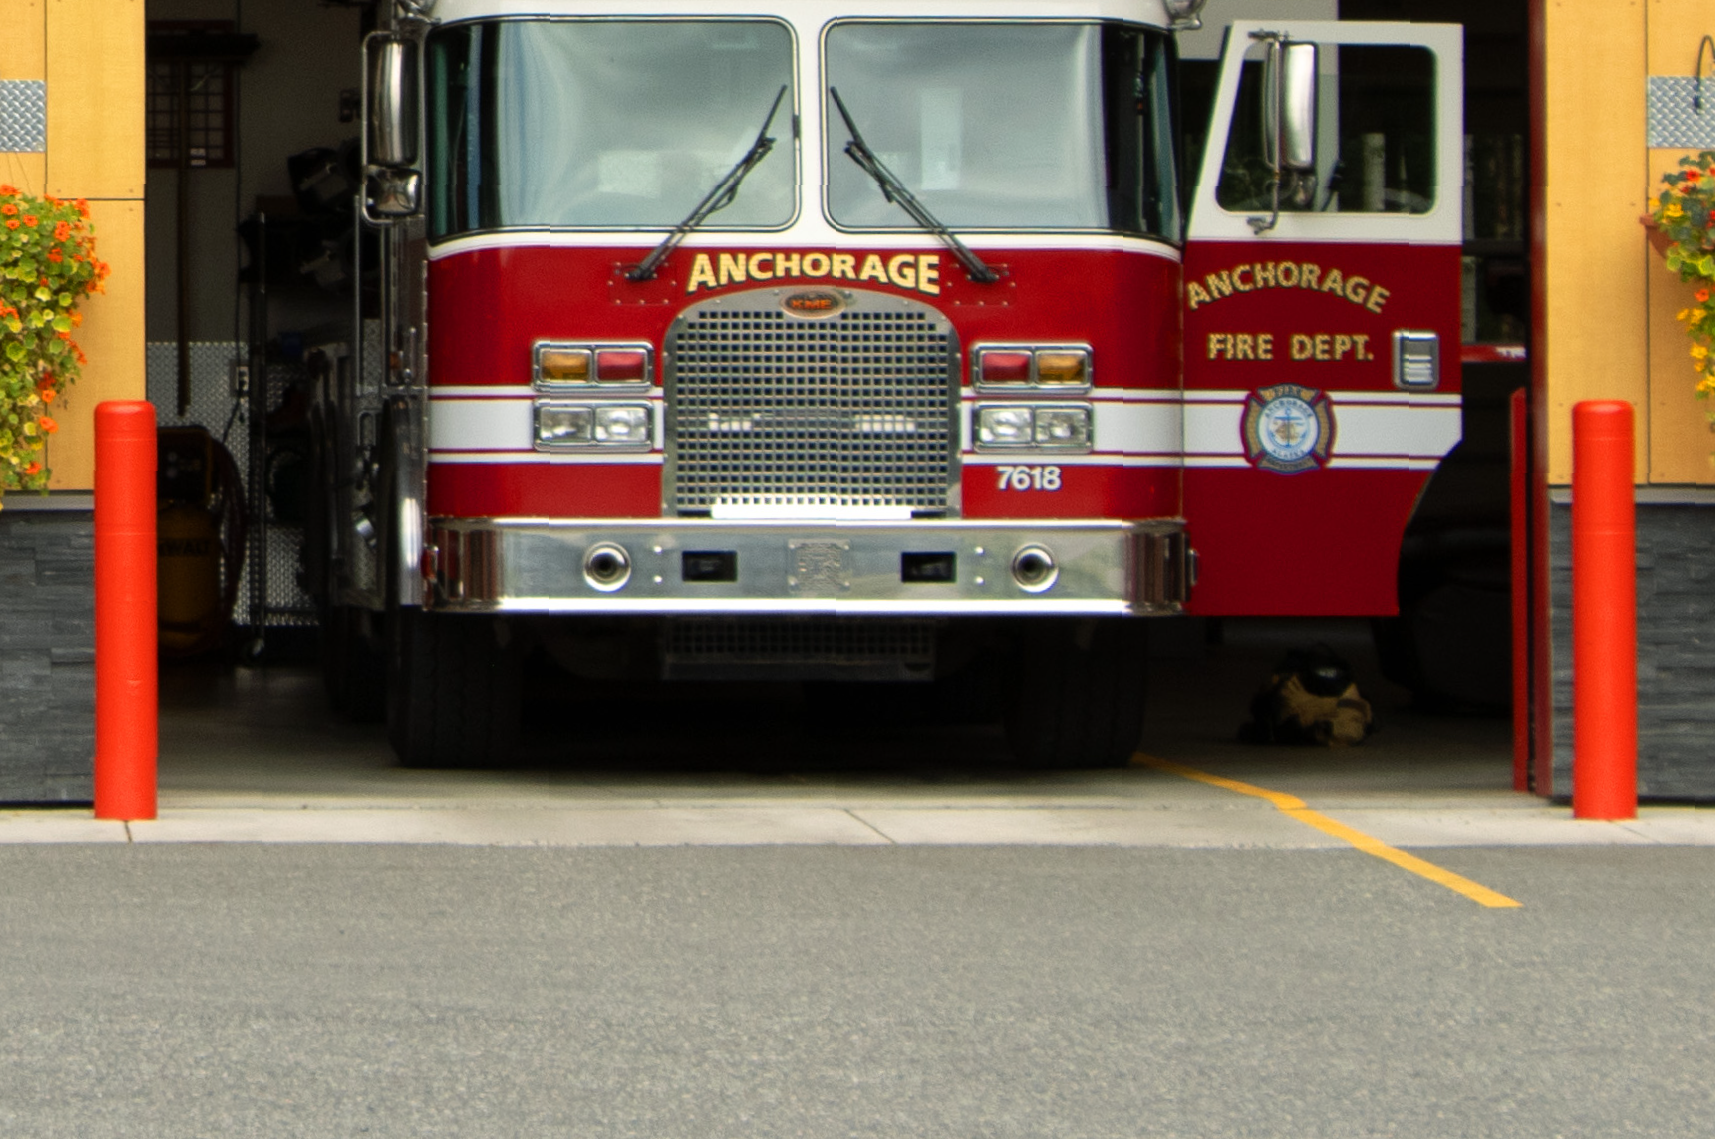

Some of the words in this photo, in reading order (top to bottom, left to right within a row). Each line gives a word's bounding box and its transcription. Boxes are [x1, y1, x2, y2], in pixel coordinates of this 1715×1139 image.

[686, 252, 940, 295] ANCHORAGE
[1187, 261, 1391, 313] ANCHORAGE
[791, 299, 832, 310] KME
[1207, 333, 1273, 361] FIRE
[1291, 333, 1374, 361] DEPT.
[996, 465, 1062, 492] 7618
